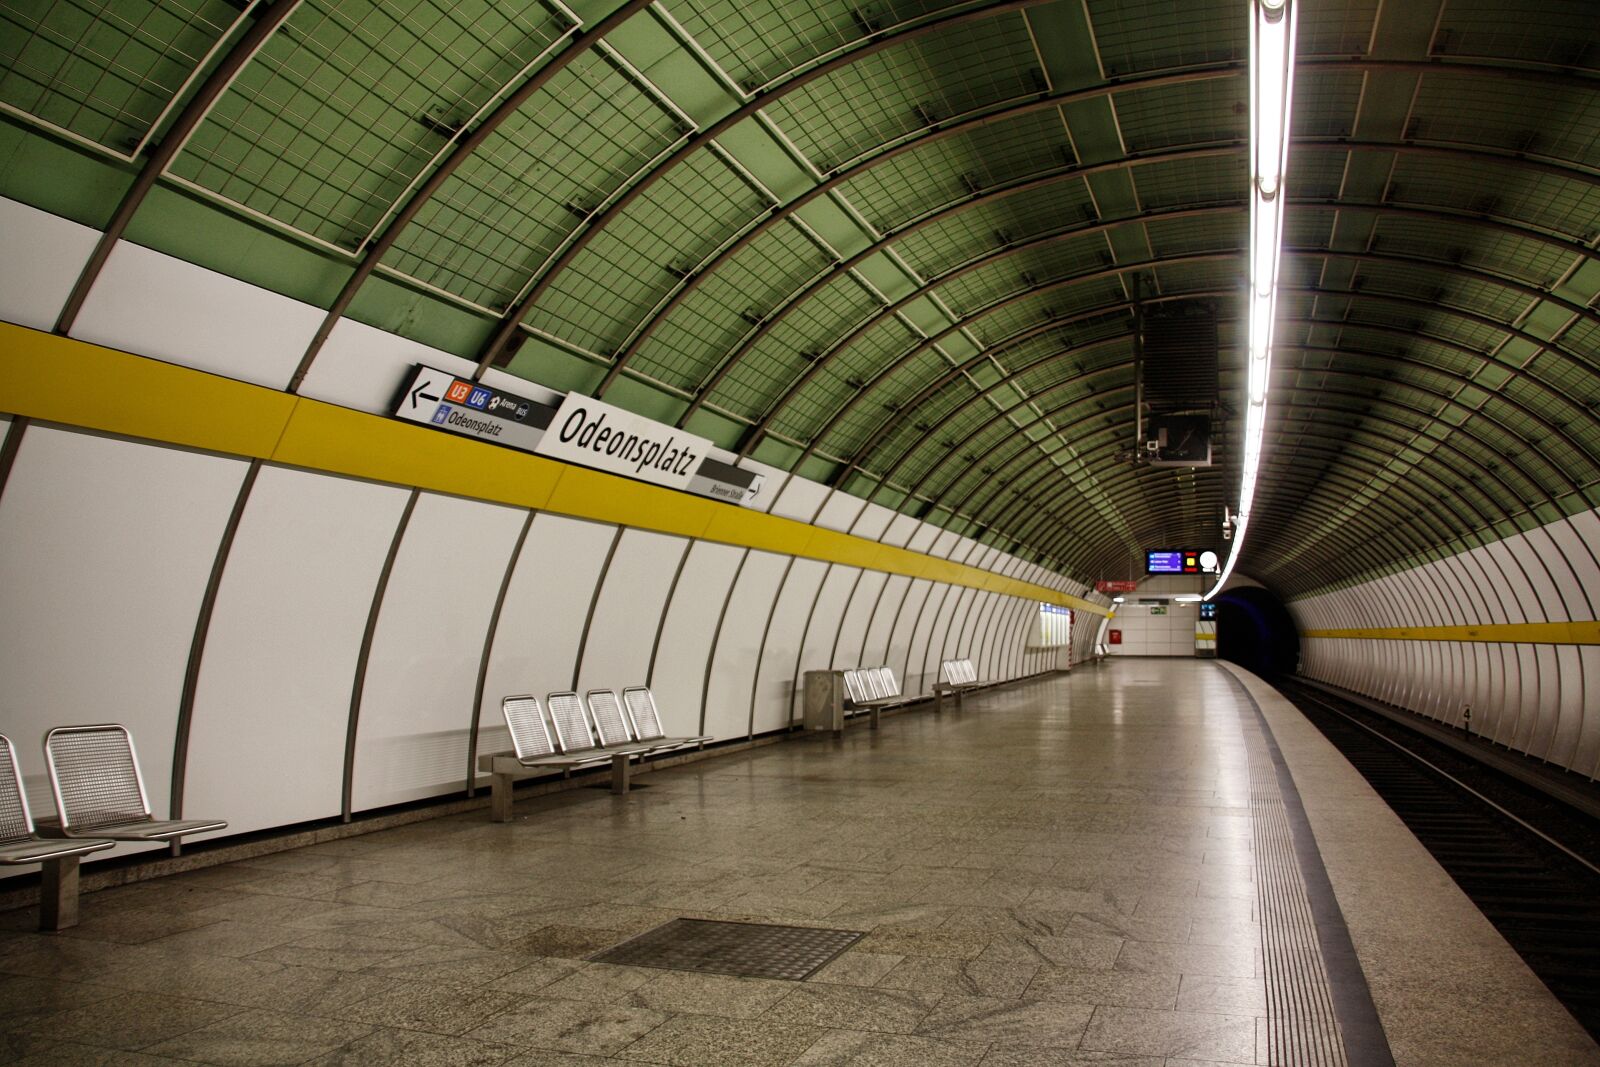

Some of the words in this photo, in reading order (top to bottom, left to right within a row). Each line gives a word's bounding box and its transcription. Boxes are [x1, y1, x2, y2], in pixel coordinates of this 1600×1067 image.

[452, 384, 468, 400] U3
[470, 390, 487, 406] U6
[499, 398, 517, 410] Arena
[448, 411, 503, 437] Odeonsplatz
[559, 408, 697, 477] Odeonsplatz
[1463, 708, 1471, 720] 4
